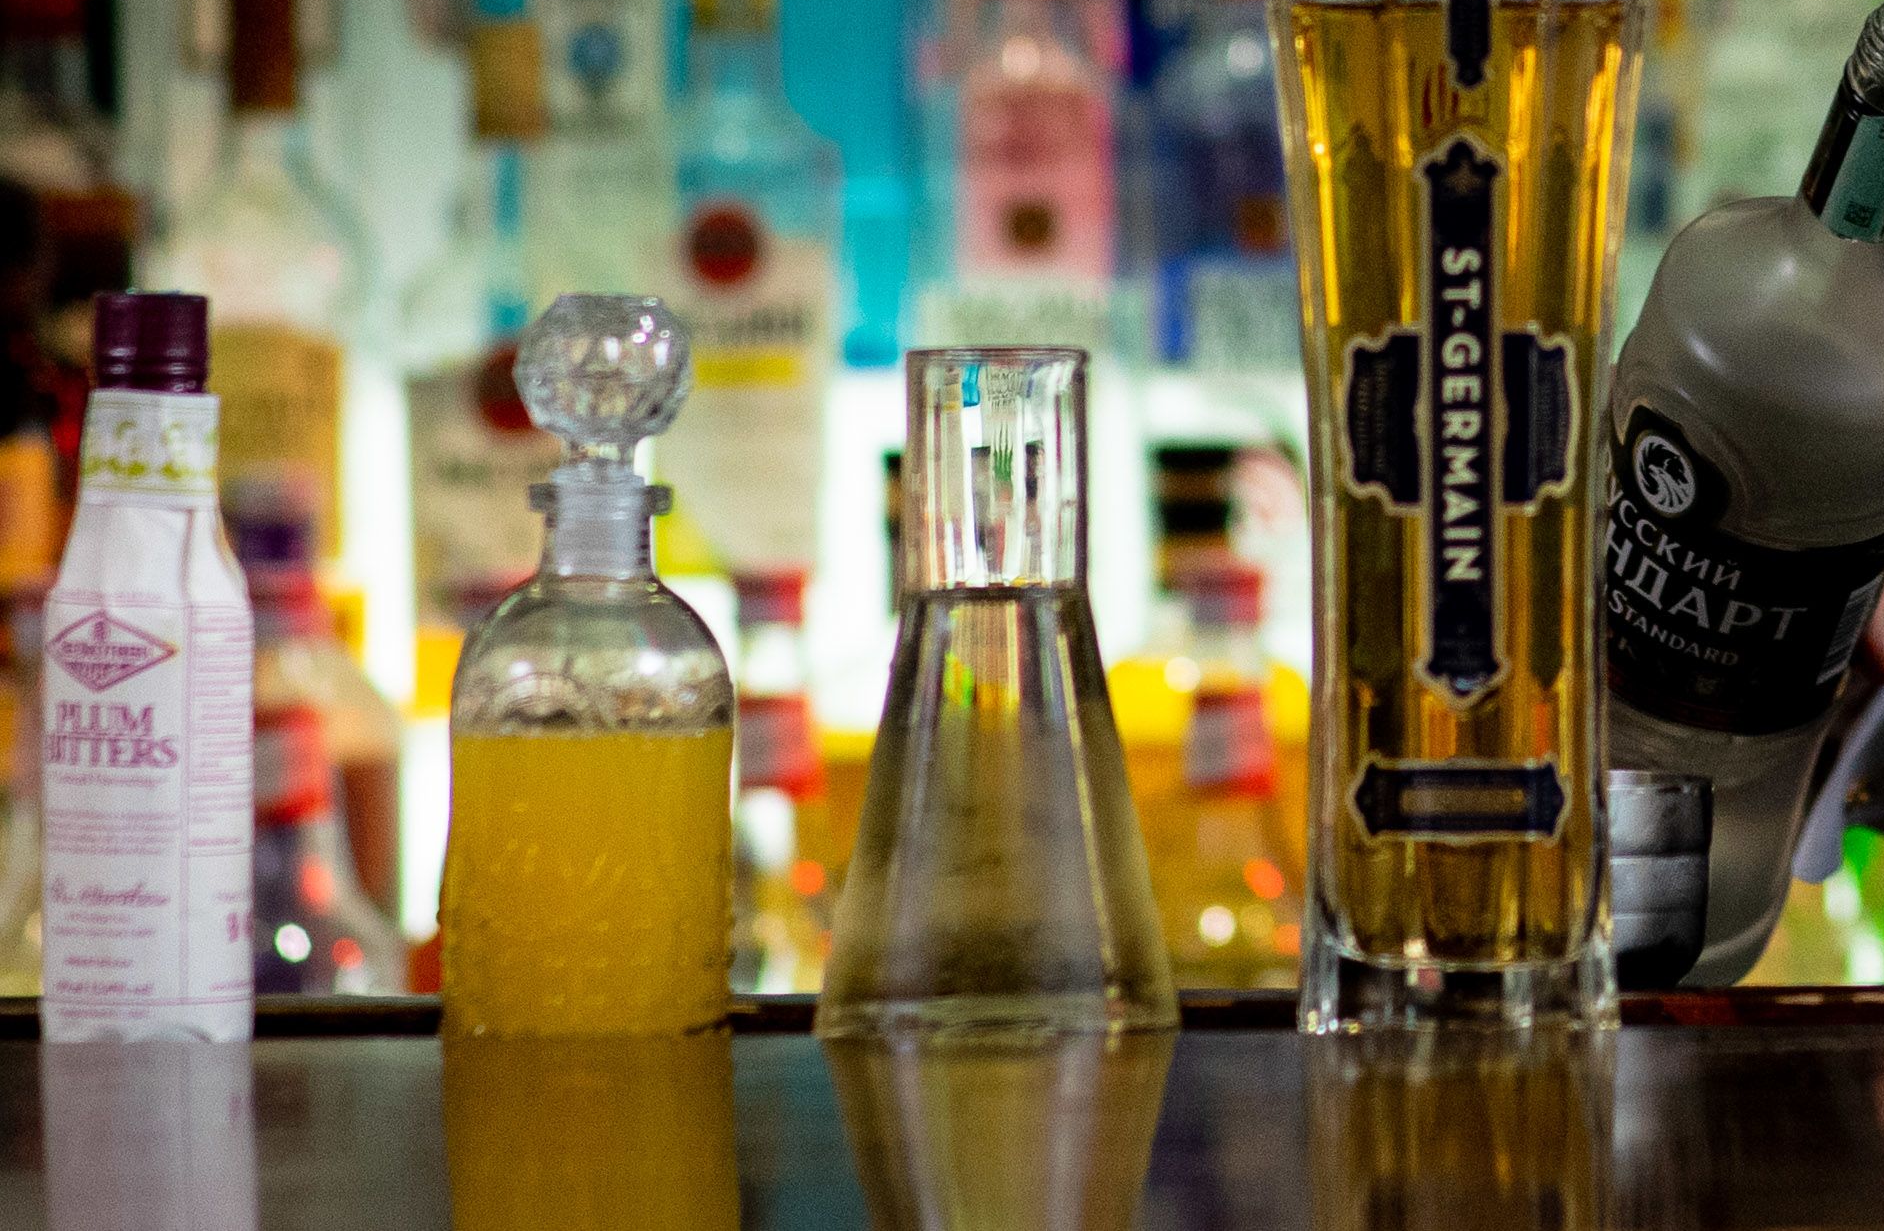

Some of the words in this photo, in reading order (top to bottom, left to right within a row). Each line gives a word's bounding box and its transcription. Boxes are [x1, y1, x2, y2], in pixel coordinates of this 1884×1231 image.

[1442, 248, 1482, 581] ST-GERMAIN
[1605, 475, 1741, 590] УССКИЙ
[1606, 519, 1808, 641] НДАРТ
[1608, 589, 1740, 666] STANDARD
[57, 700, 153, 735] PLUM
